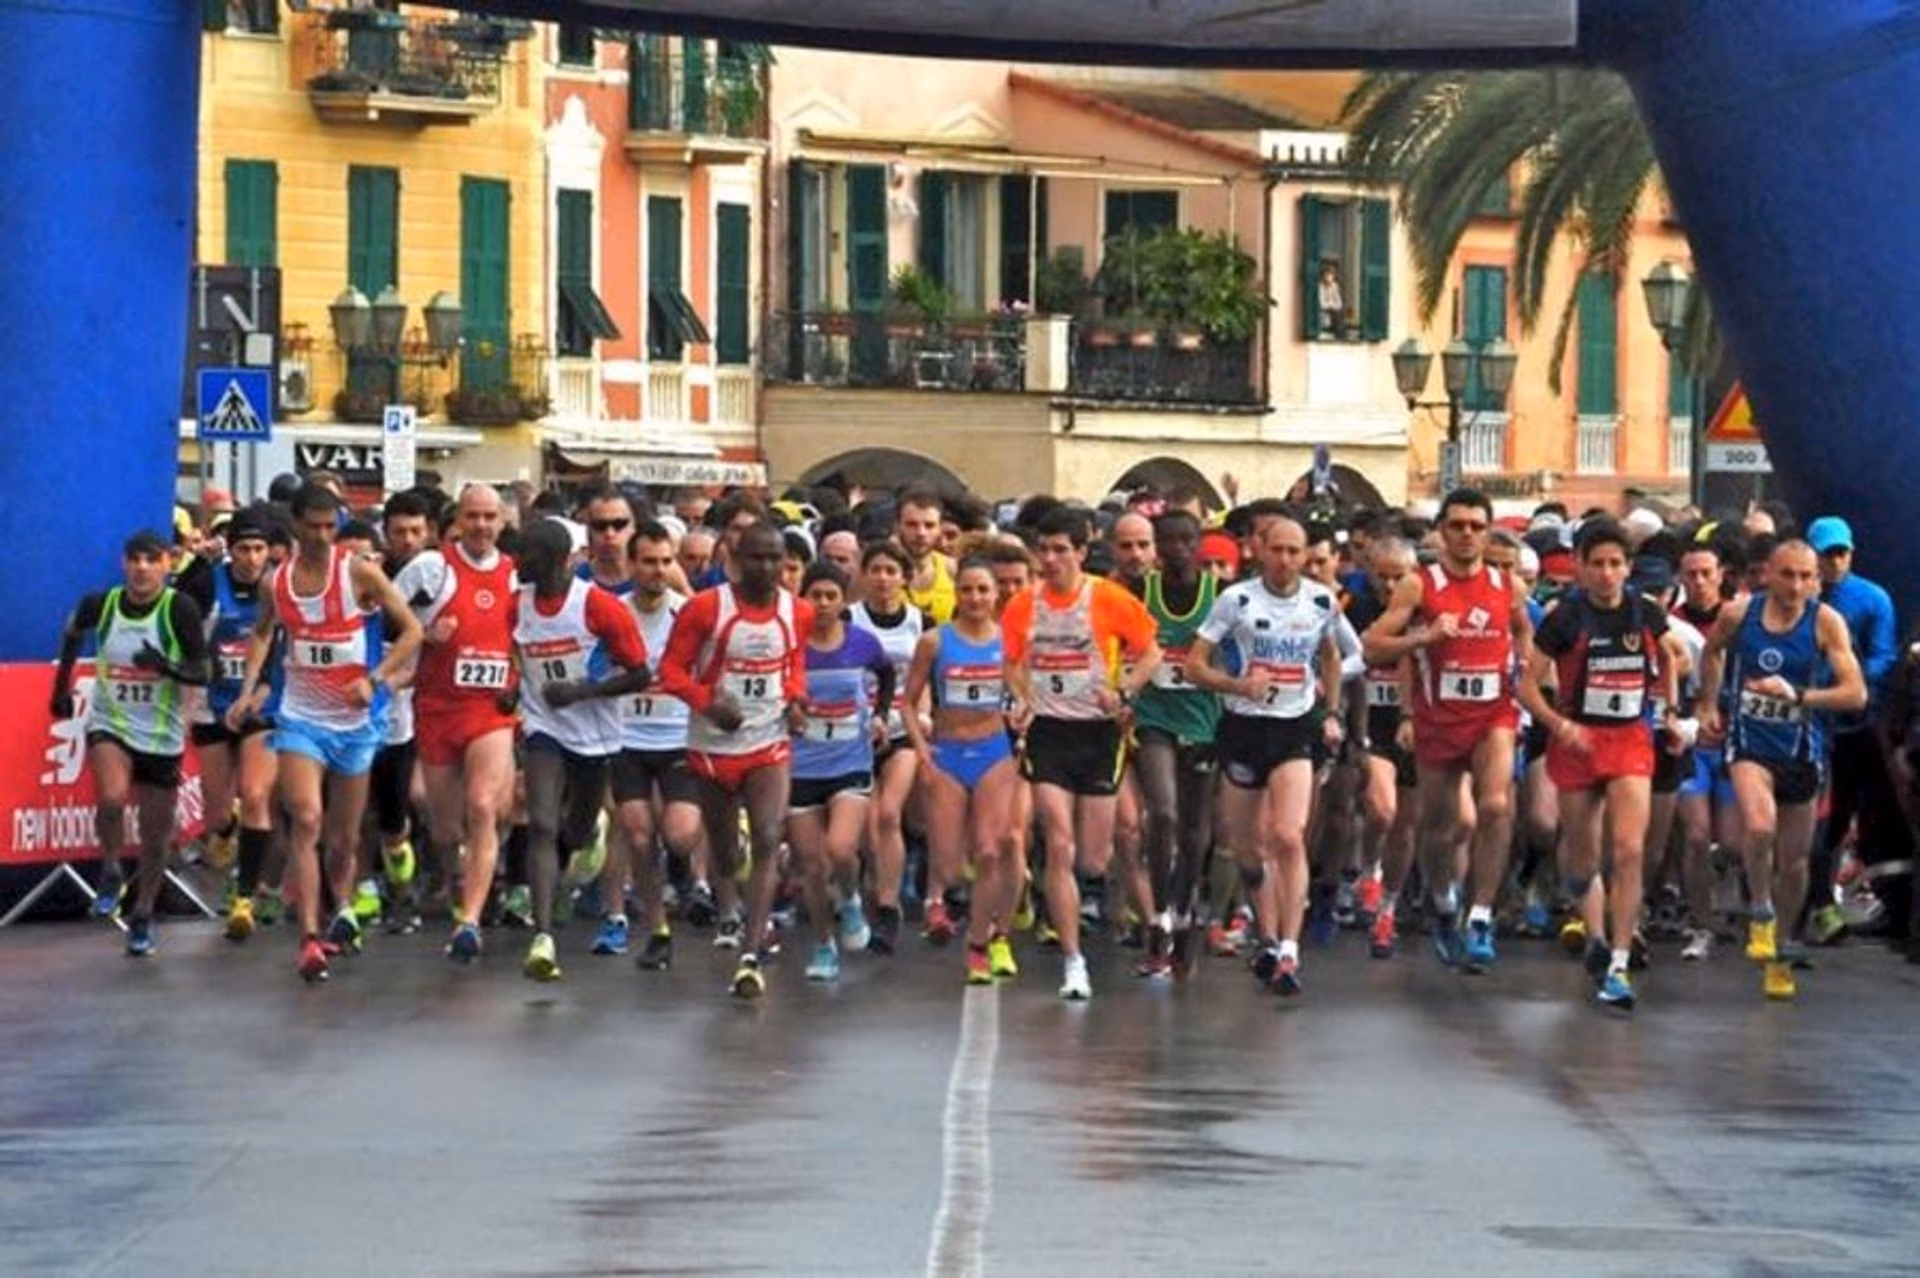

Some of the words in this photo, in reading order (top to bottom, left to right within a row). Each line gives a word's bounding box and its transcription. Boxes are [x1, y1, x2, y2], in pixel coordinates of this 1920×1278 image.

[1051, 674, 1064, 694] 5
[1171, 665, 1184, 684] 3
[116, 684, 154, 702] 212
[743, 677, 767, 698] 13
[634, 698, 653, 716] 17
[1608, 693, 1621, 712] 4
[13, 808, 47, 851] new
[51, 794, 100, 848] balanc
